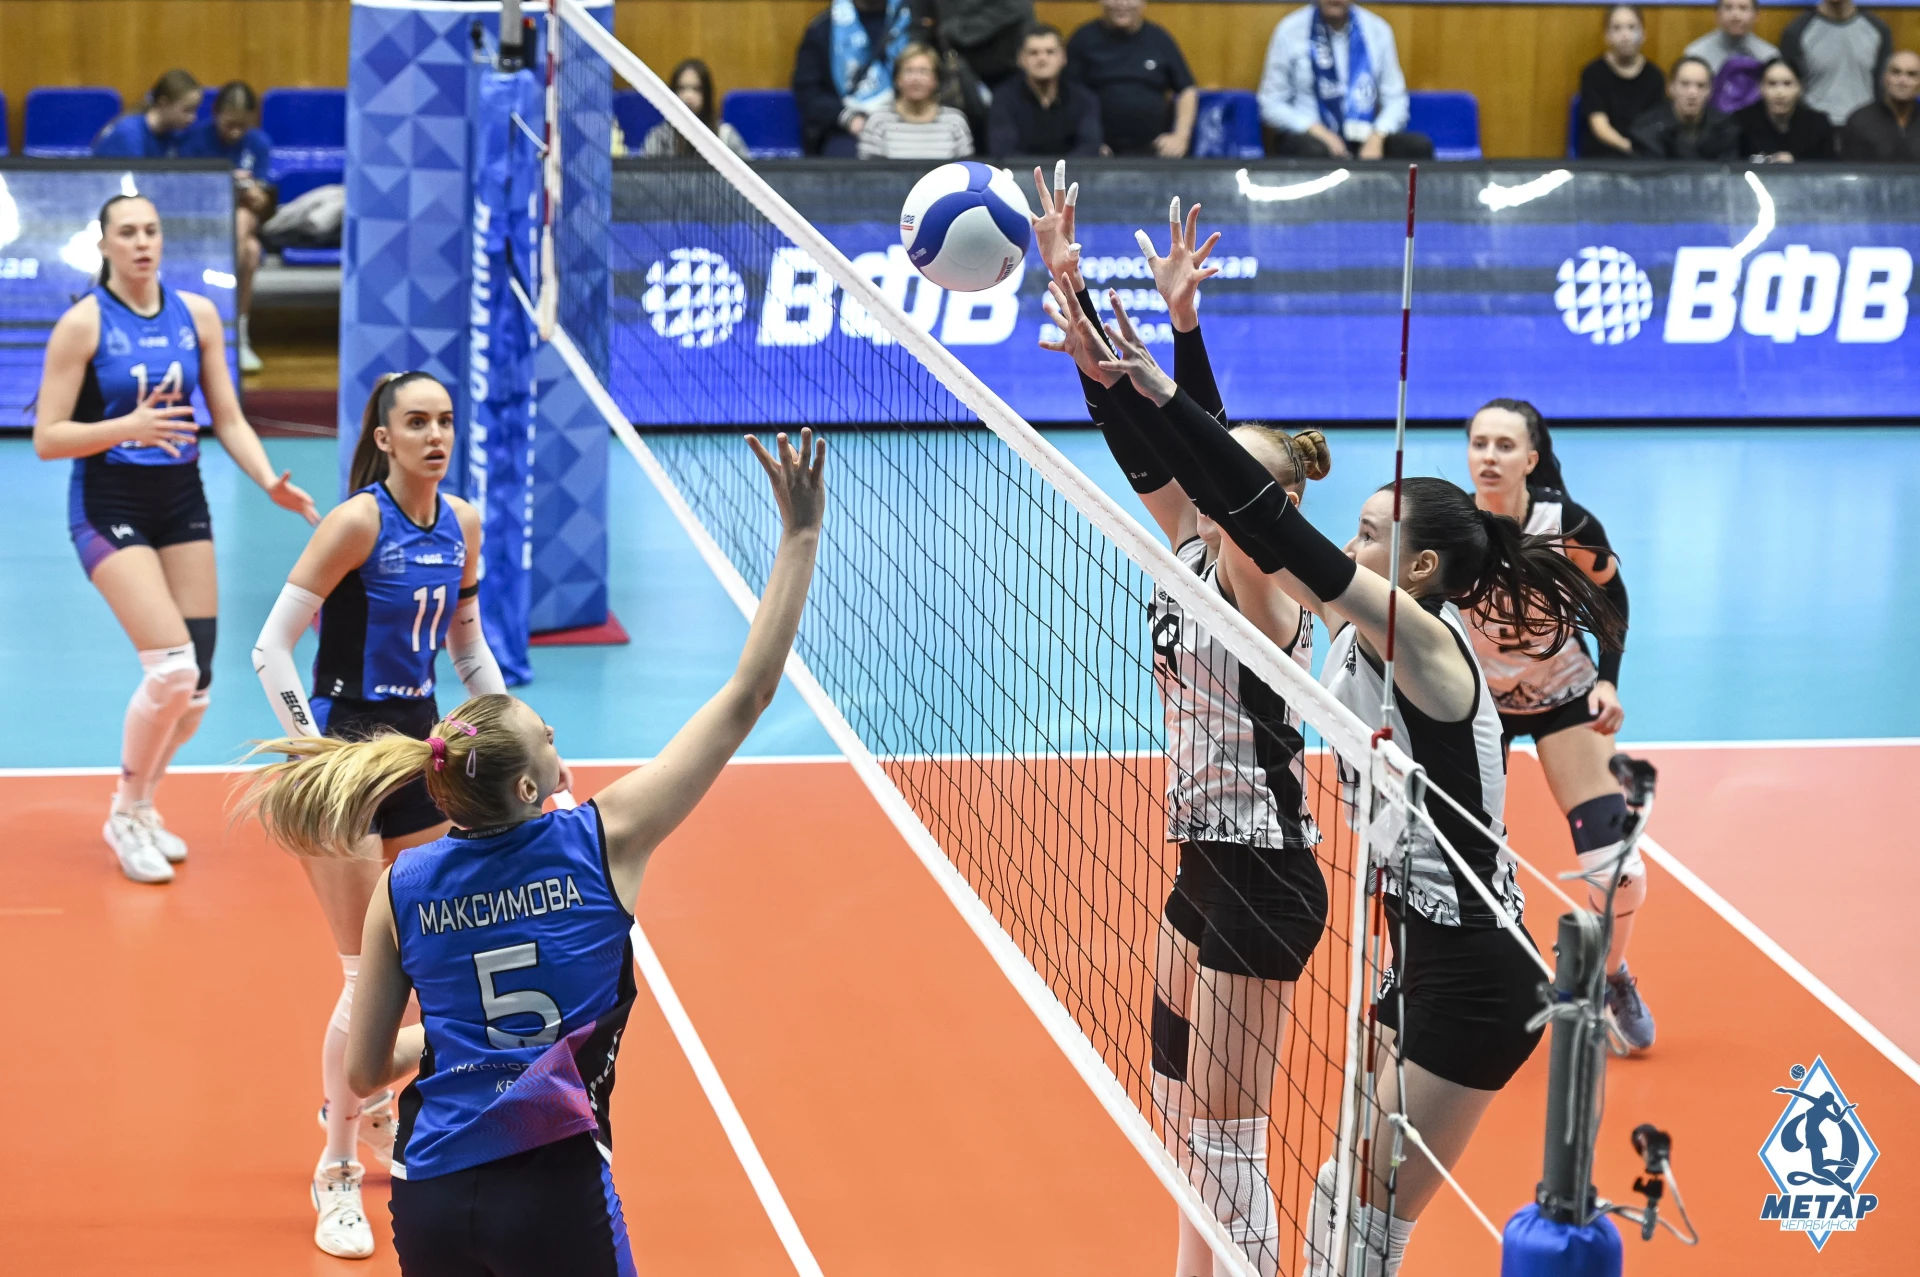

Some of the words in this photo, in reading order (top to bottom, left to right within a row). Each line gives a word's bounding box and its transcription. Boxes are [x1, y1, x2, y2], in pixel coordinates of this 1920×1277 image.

[1662, 245, 1913, 344] ВФВ
[130, 360, 184, 408] 14
[411, 584, 447, 653] 11
[418, 875, 584, 936] МАКСИМОВА
[473, 942, 563, 1049] 5
